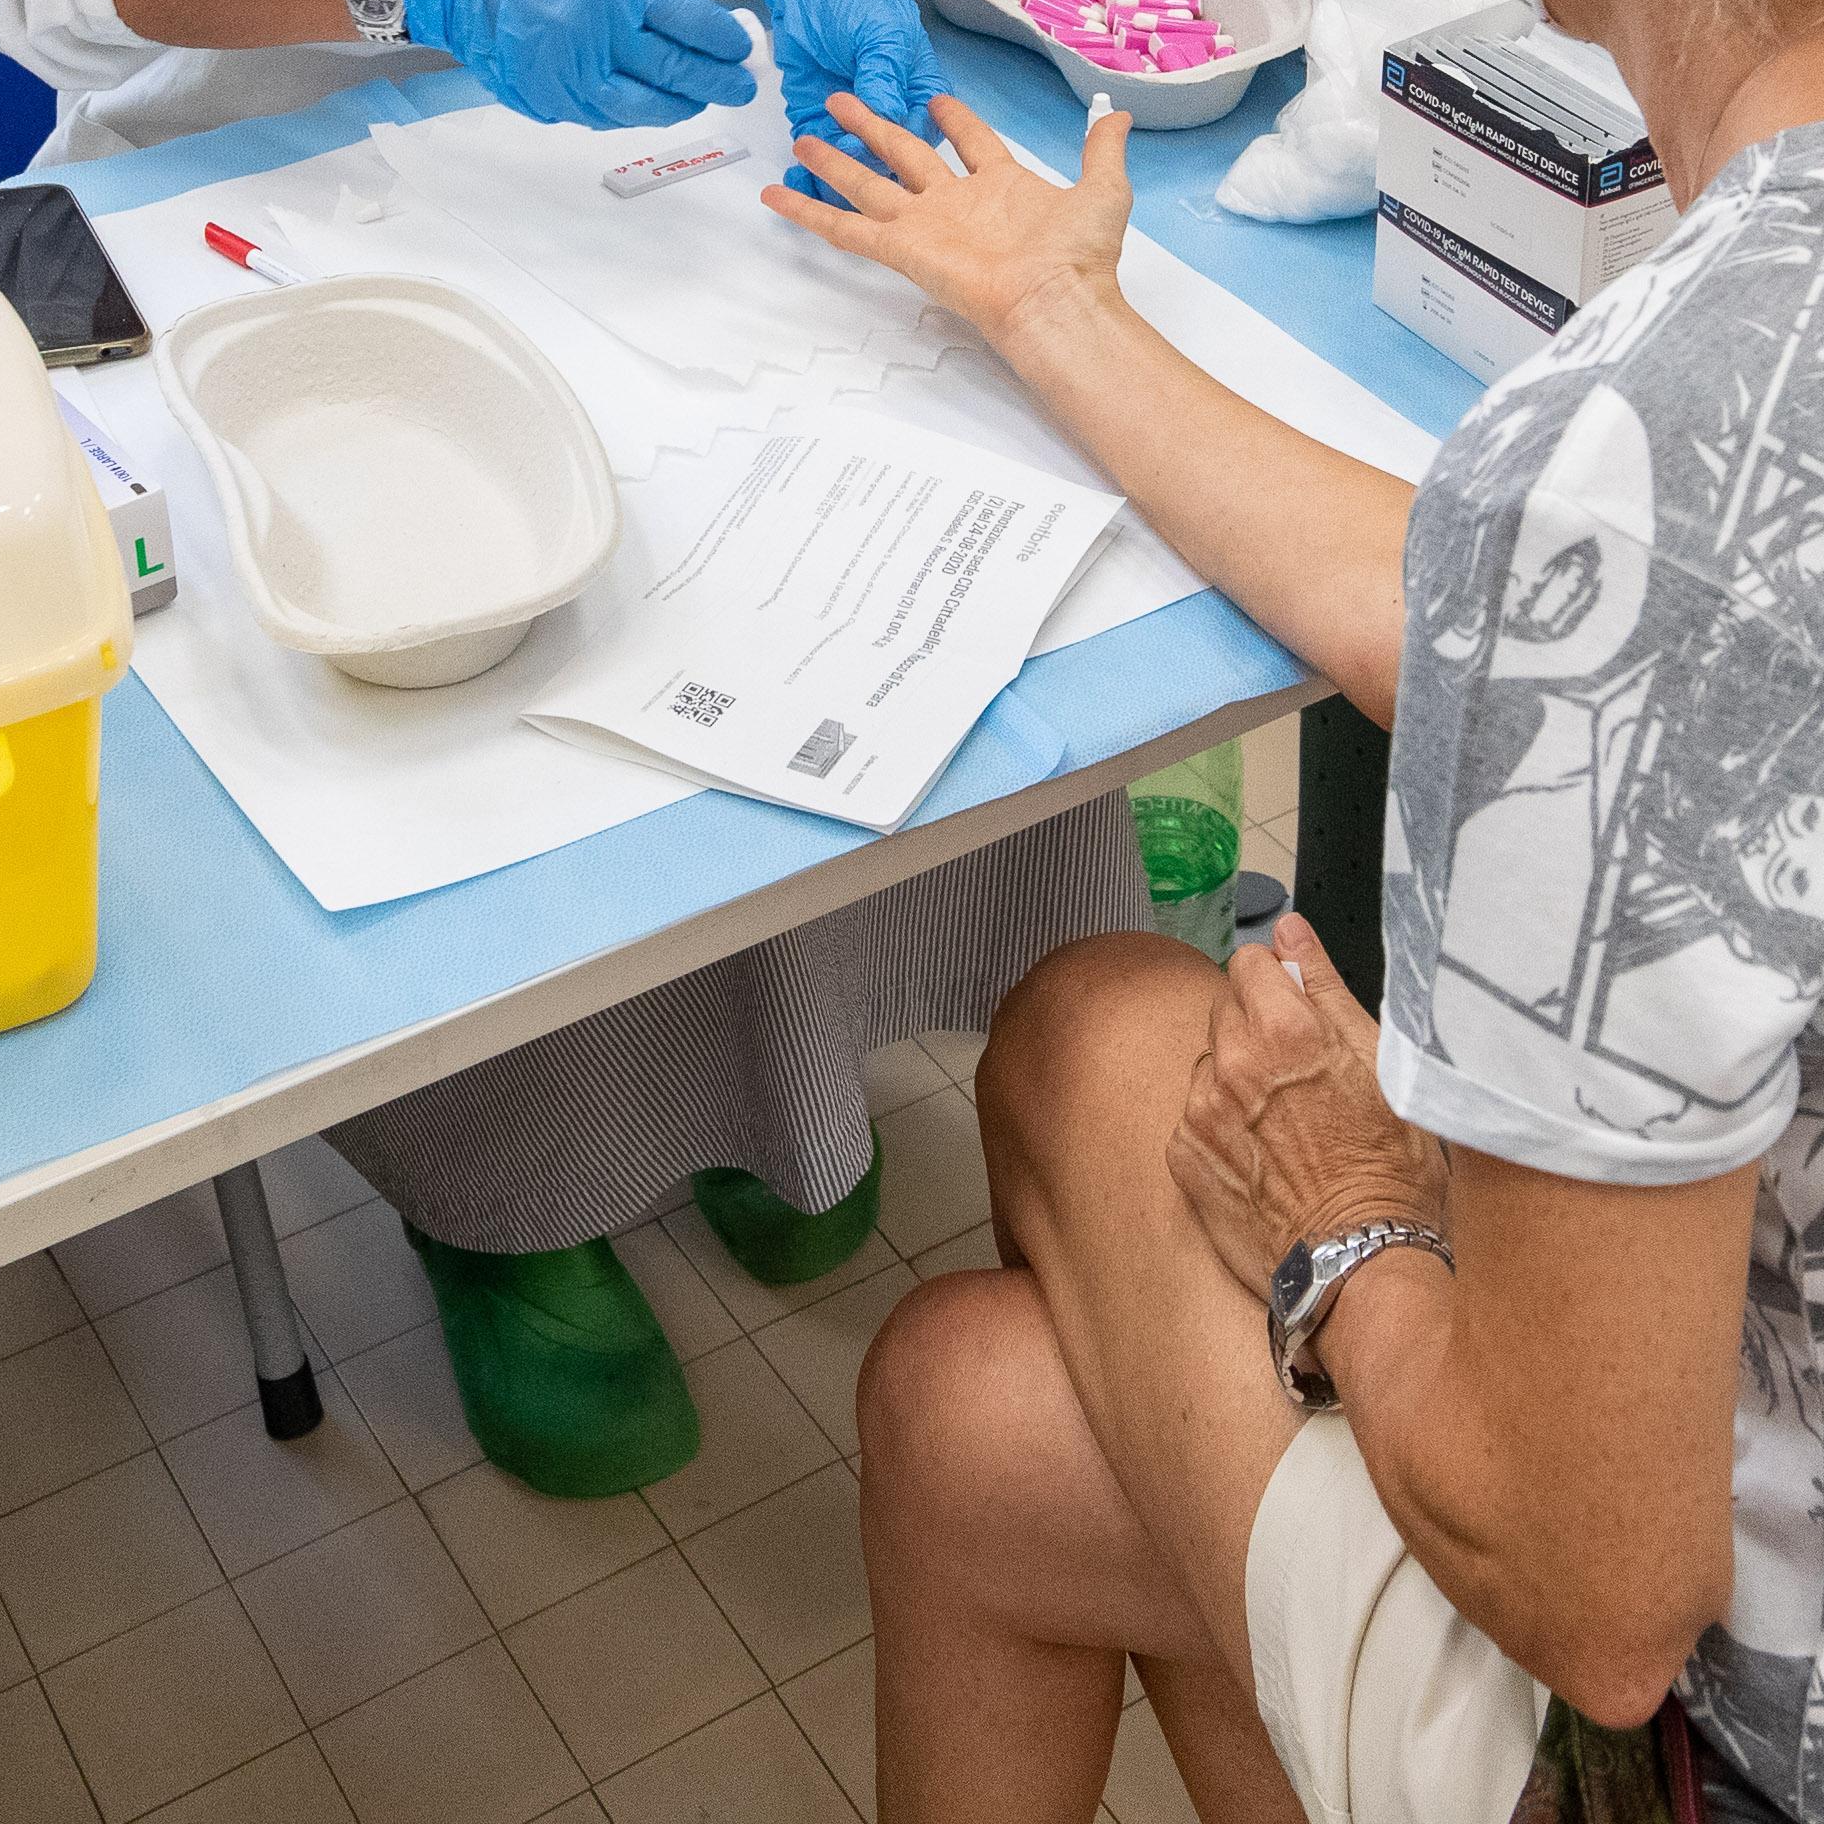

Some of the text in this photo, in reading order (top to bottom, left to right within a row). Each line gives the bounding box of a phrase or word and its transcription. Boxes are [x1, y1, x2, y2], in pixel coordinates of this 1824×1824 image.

[1405, 81, 1583, 188] COVID-19 IgG/IgM RAPID TEST DEVICE
[1400, 207, 1559, 320] COVID-19 IgG/IgM RAPID TEST DEVICE
[88, 446, 117, 469] LARGE
[114, 470, 132, 483] 100
[963, 488, 986, 506] CDS
[939, 493, 1008, 577] (2) del 24-08-2020
[942, 502, 976, 539] Cittadella
[975, 499, 1026, 557] Prenotazione
[1016, 502, 1067, 563] eventbrite
[134, 537, 165, 578] L
[960, 553, 988, 578] sede
[904, 565, 933, 597] Ferrara
[947, 575, 975, 600] CDS
[896, 593, 917, 610] (2)
[921, 596, 962, 652] Cittadella
[886, 670, 907, 683] di
[863, 677, 901, 709] Ferrara
